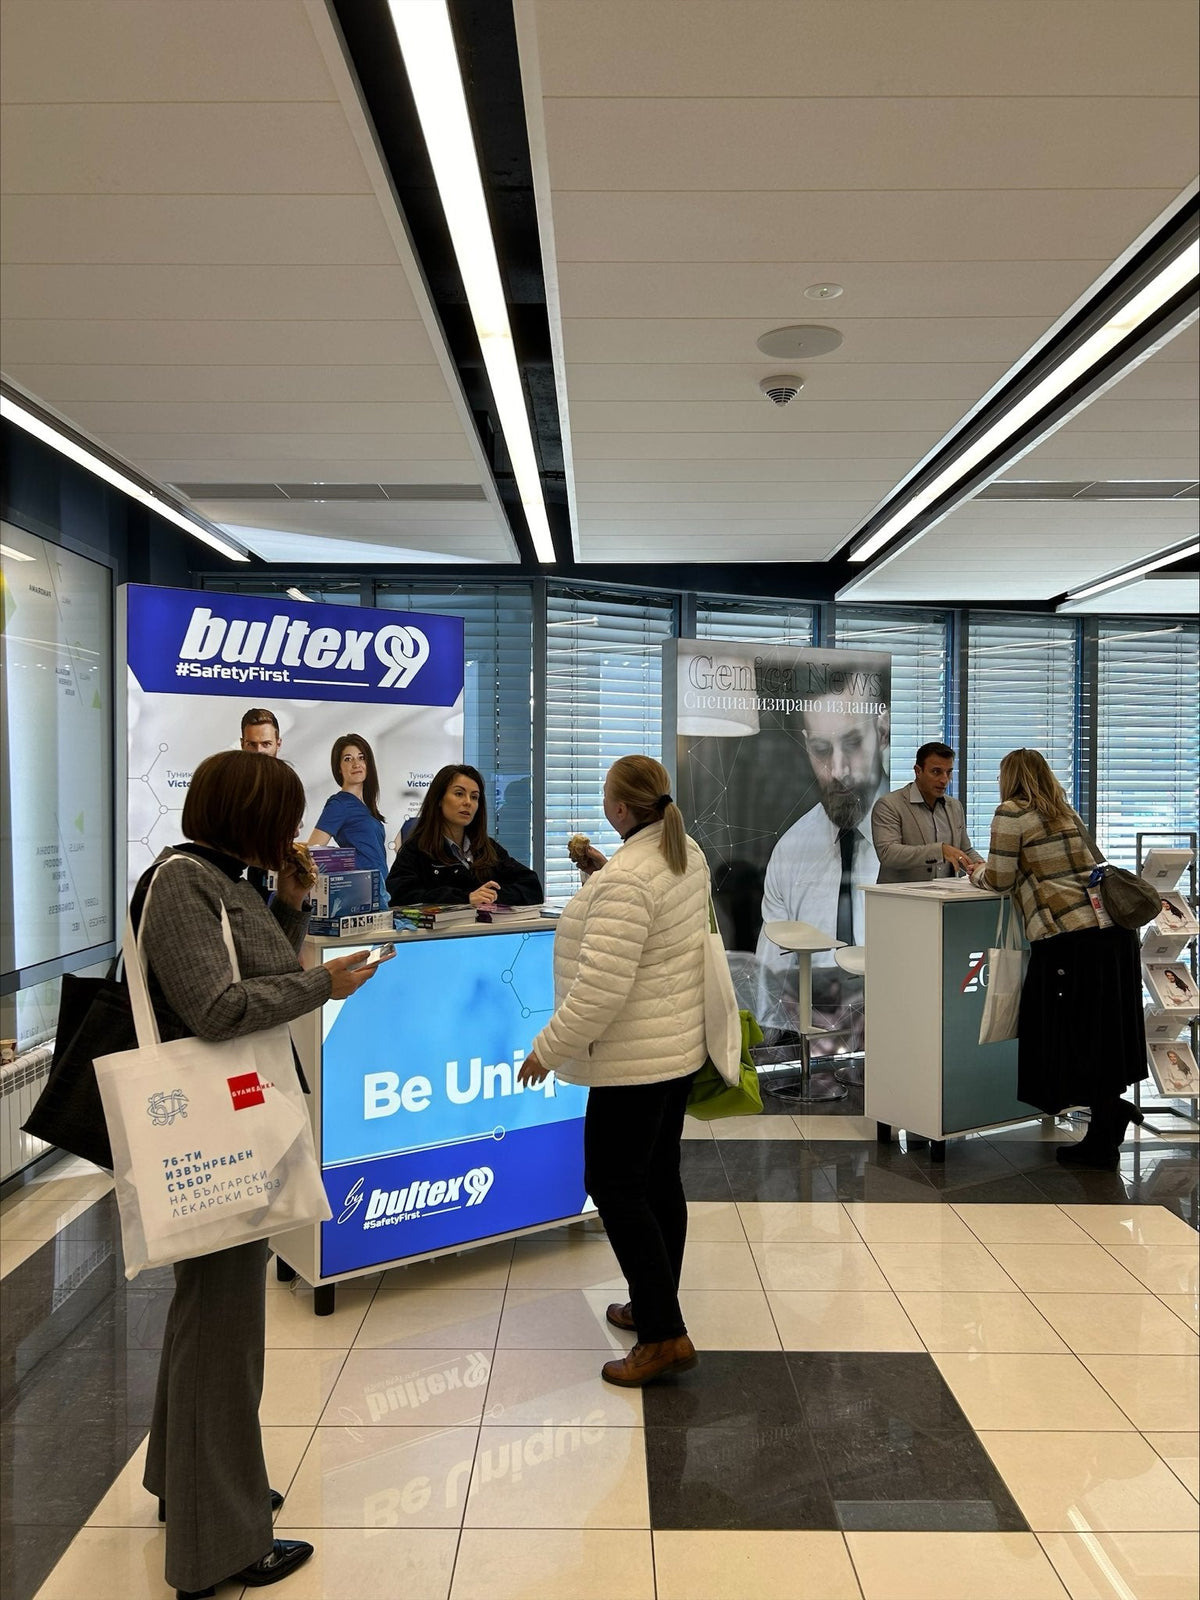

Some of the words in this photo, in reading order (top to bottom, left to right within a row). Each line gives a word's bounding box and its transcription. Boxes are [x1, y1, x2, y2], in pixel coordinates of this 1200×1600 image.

[175, 662, 291, 684] #SafetyFirst
[688, 654, 799, 694] Genica
[806, 661, 882, 697] News
[683, 690, 823, 715] Специализирано
[826, 699, 887, 717] издание
[166, 770, 193, 779] Туник
[231, 1082, 276, 1098] БУЛМЕДИКА
[364, 1068, 432, 1121] Be
[162, 1151, 202, 1168] 76-ТИ
[165, 1150, 254, 1181] ИЗВЪНРЕДЕН
[167, 1173, 213, 1193] СЪБОР
[170, 1192, 188, 1206] НА
[193, 1170, 269, 1199] БЪЛГАРСКИ
[172, 1190, 242, 1218] ЛЕКАРСКИ
[246, 1178, 282, 1197] СЪЮЗ
[337, 1176, 365, 1225] by
[362, 1210, 421, 1230] #SafetyFirst
